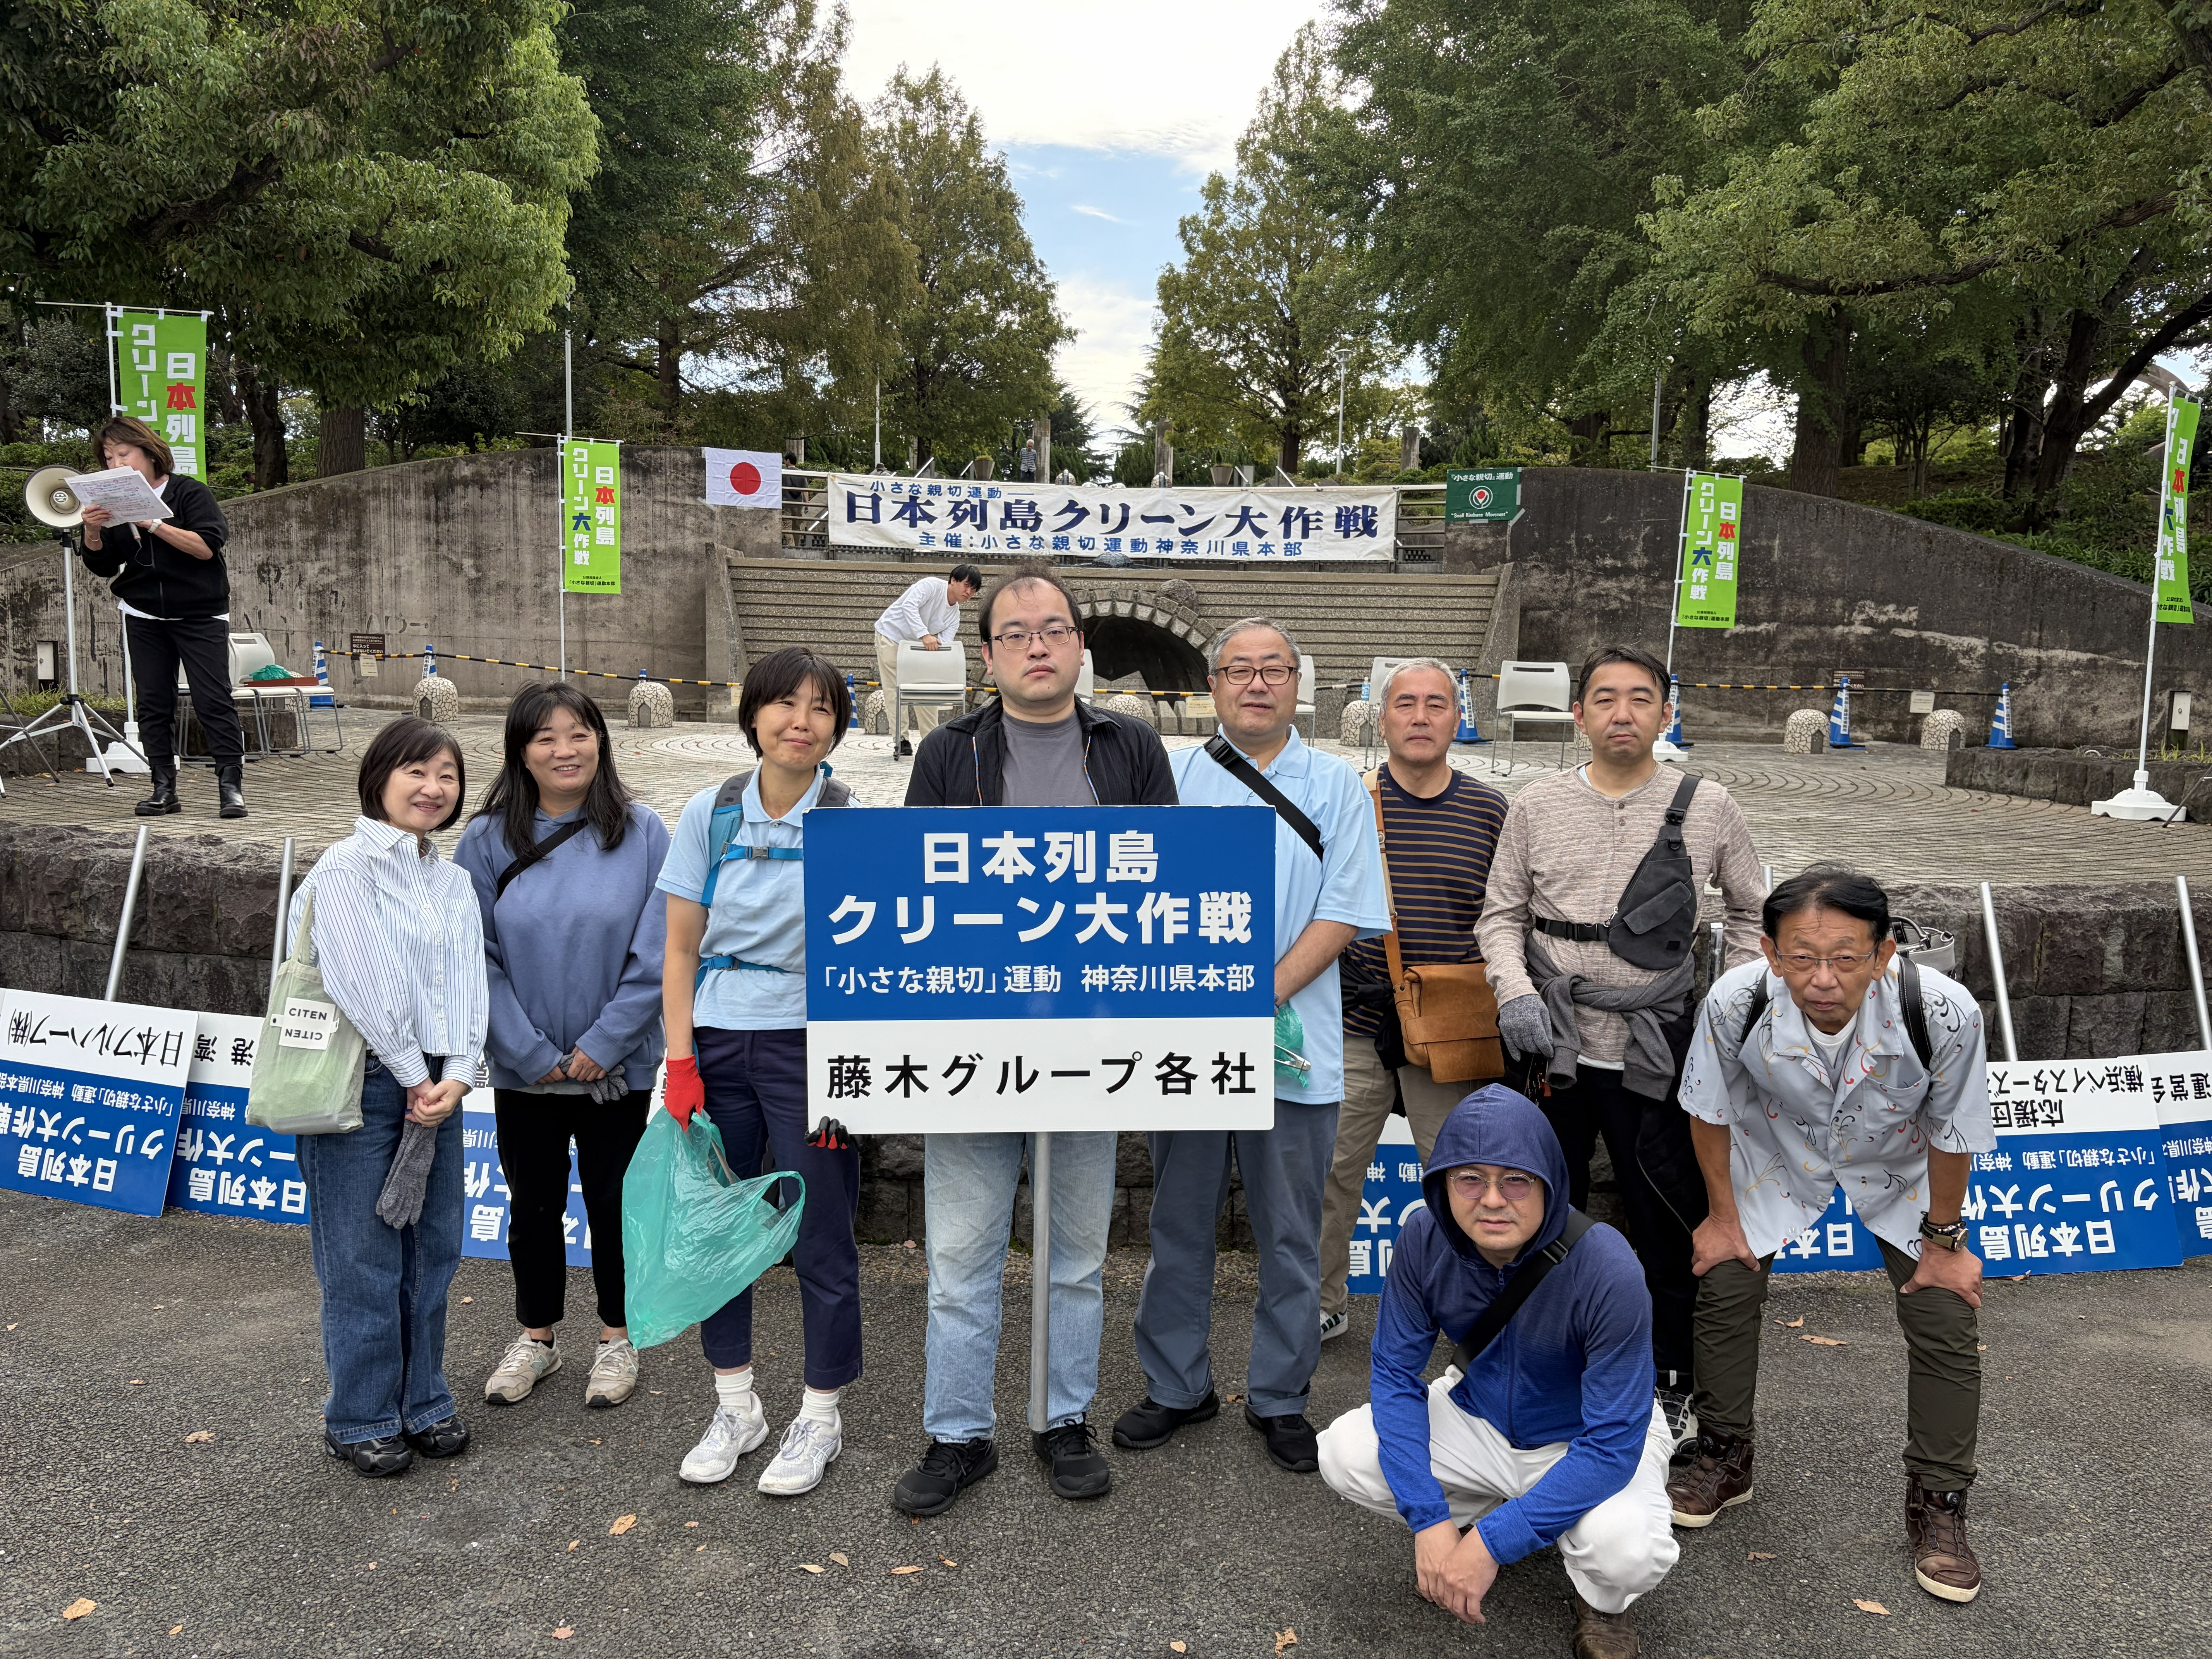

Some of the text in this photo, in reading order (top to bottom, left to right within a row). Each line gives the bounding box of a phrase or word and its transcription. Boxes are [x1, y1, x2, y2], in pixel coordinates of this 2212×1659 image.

[132, 325, 160, 435] クリーン
[166, 353, 198, 475] 日本列島
[572, 448, 591, 565] クリーン大作戦
[595, 467, 615, 545] 日本列島
[871, 480, 1002, 498] 小さな親切運動
[2172, 438, 2188, 554] 日本列島
[847, 490, 1379, 539] 日本列島クリーン大作戦
[1690, 482, 1714, 600] クリーン大作戦
[1715, 502, 1736, 580] 日本列島
[924, 830, 1158, 883] 日本列島
[828, 891, 1252, 945] クリーン大作戦
[825, 964, 1254, 995] 「小さな親切」運動 神奈川県本部
[285, 1029, 323, 1040] CITEN
[289, 1008, 327, 1020] CITEN
[827, 1051, 1256, 1099] 藤木グループ各社
[1987, 1064, 2145, 1097] 横浜ベイスターズ
[71, 1084, 173, 1117] 「小さな親切」運動
[1990, 1099, 2064, 1128] 応援団
[17, 1144, 118, 1192] 日本列島
[2022, 1146, 2155, 1170] 「小さな親切」運動
[188, 1167, 307, 1214] 日本列島
[1980, 1219, 2116, 1261] 日本列島
